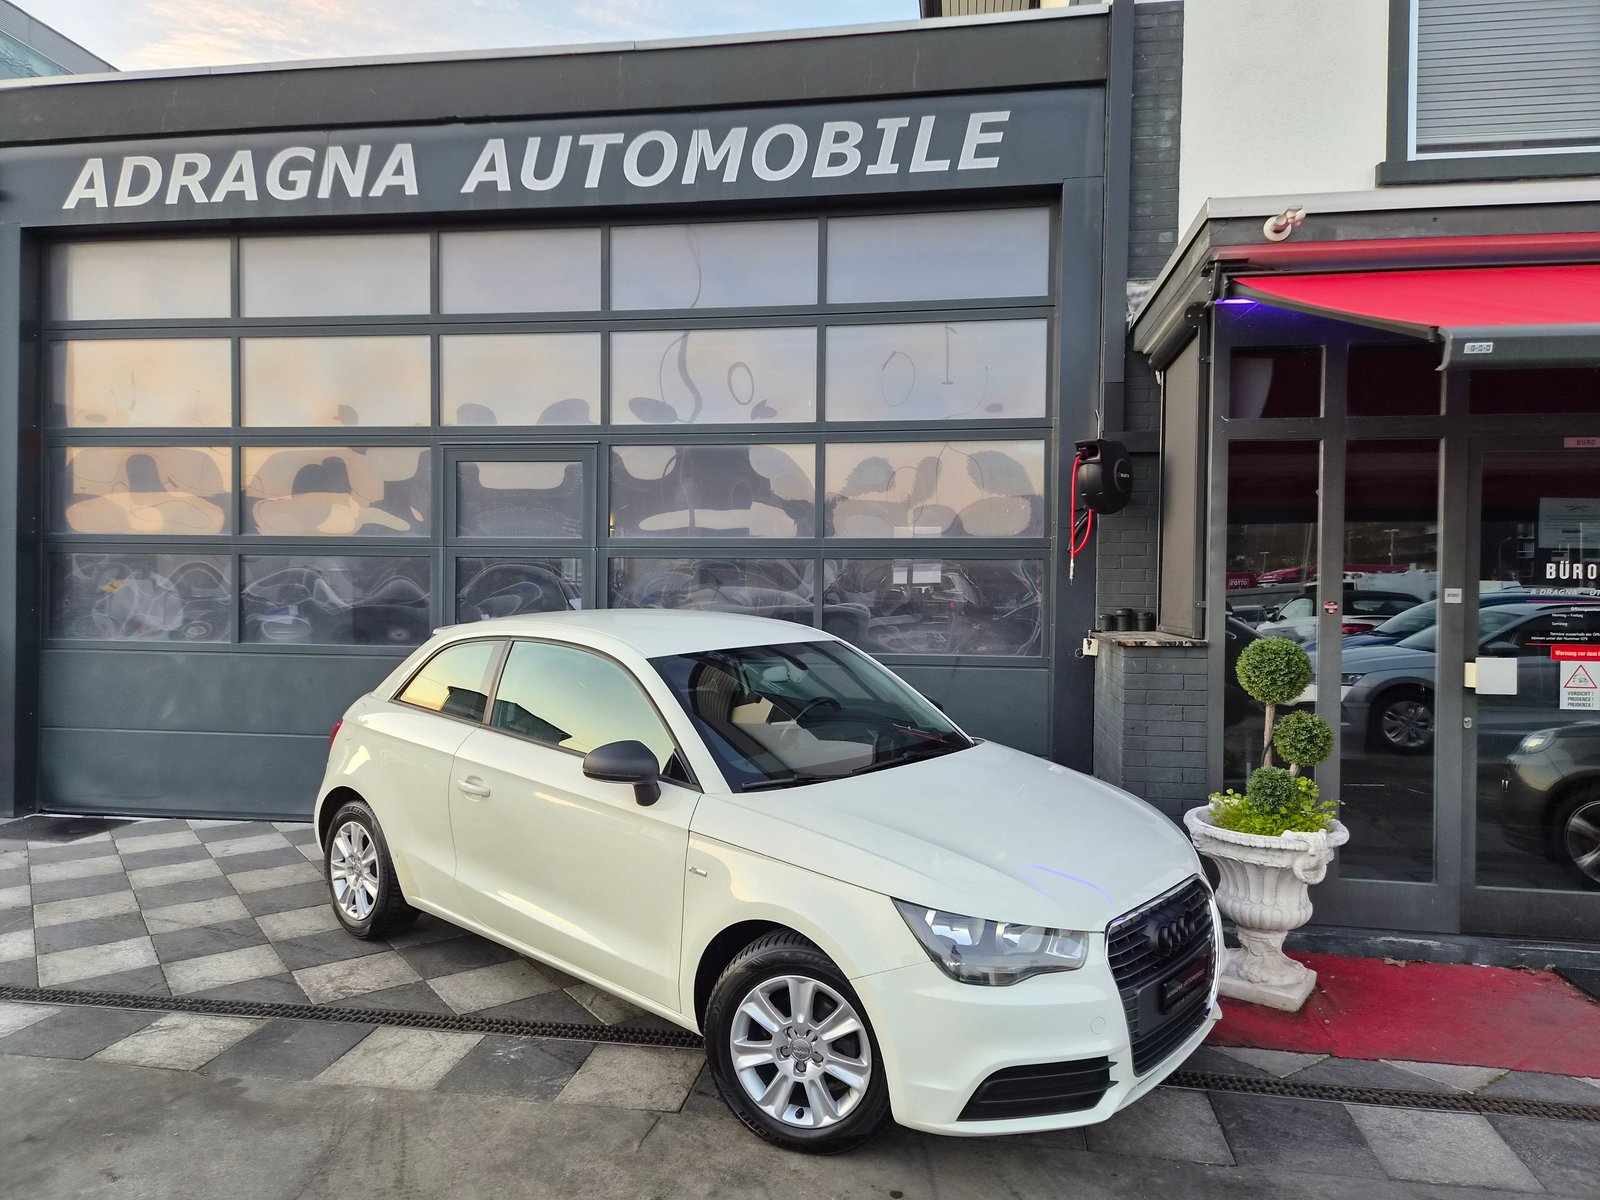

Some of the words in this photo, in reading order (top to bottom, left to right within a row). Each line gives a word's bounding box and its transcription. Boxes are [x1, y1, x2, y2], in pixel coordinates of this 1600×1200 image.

[62, 143, 419, 210] ADRAGNA
[460, 111, 1011, 194] AUTOMOBILE
[1545, 560, 1598, 580] BÜRO
